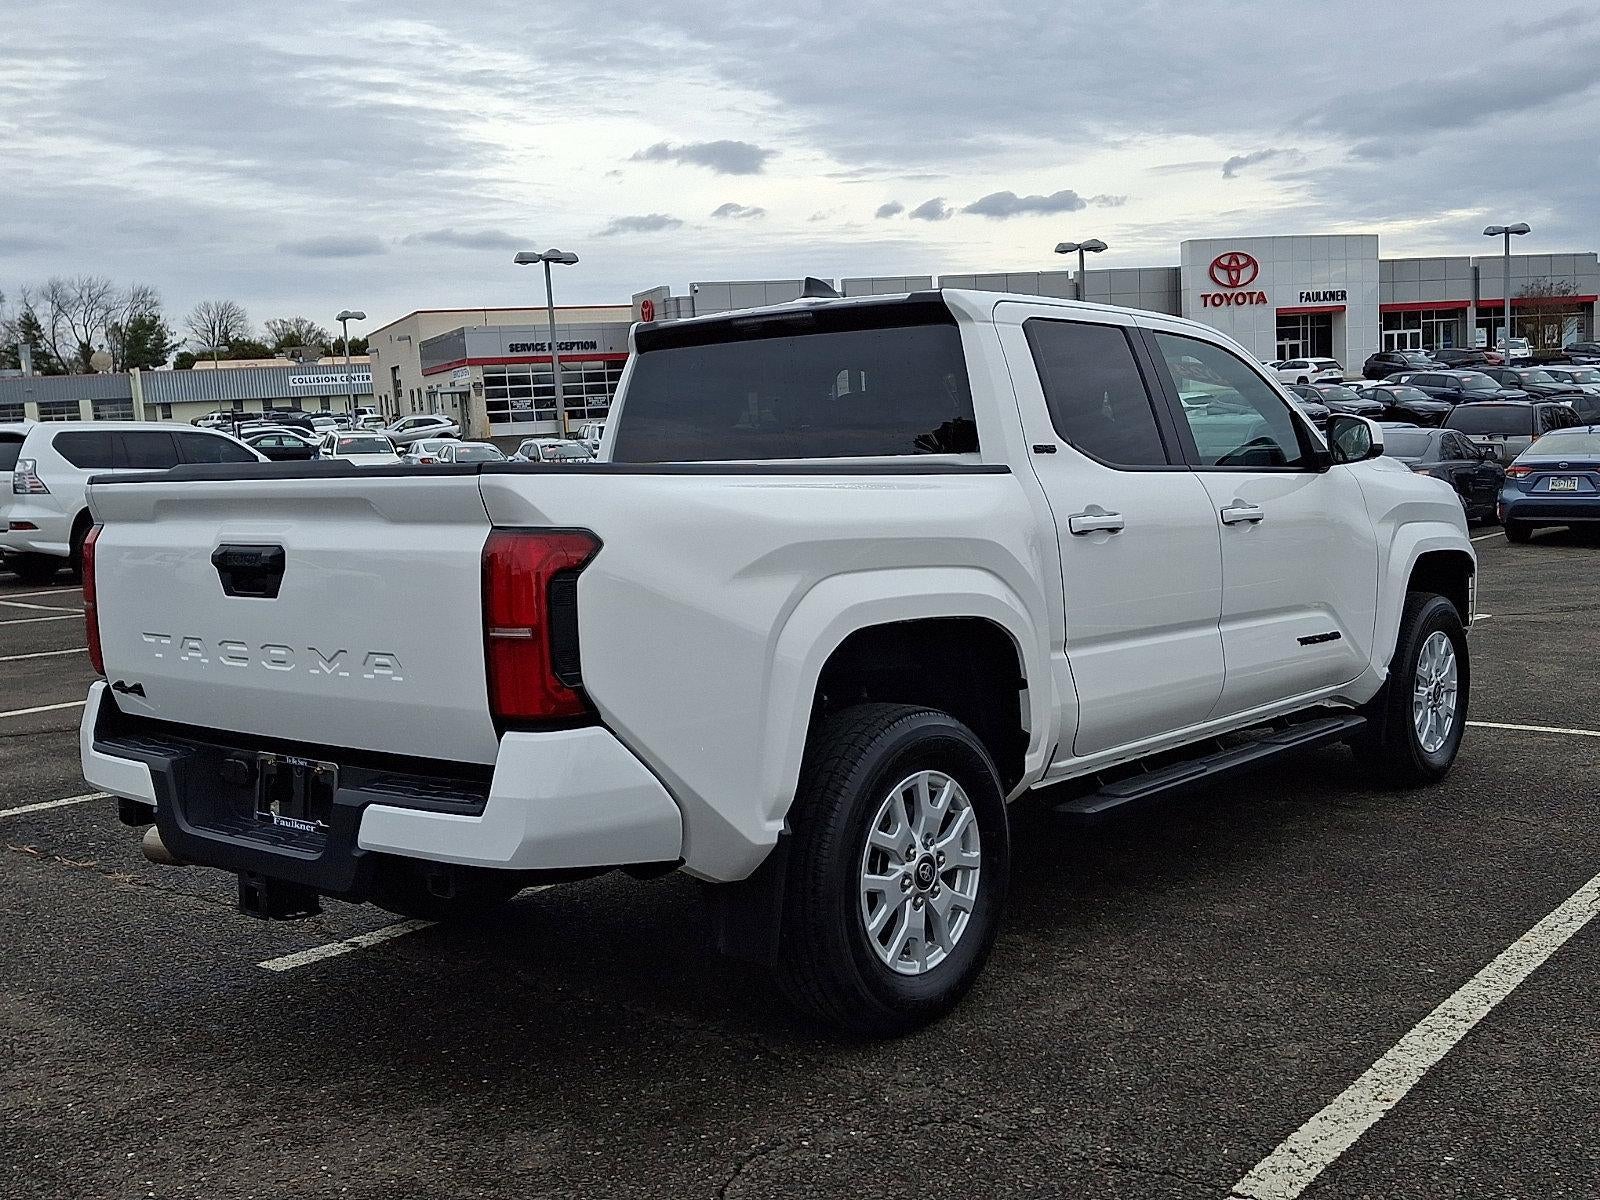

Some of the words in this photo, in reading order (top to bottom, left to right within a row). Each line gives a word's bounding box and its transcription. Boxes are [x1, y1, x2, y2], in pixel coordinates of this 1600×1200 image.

[1200, 291, 1268, 308] TOYOTA
[1299, 290, 1347, 303] FAULKNER
[509, 342, 547, 353] SERVICE
[292, 376, 338, 385] COLLISION
[340, 374, 371, 383] CENTER
[142, 632, 404, 681] TACOMA
[273, 816, 316, 832] Faulkner
